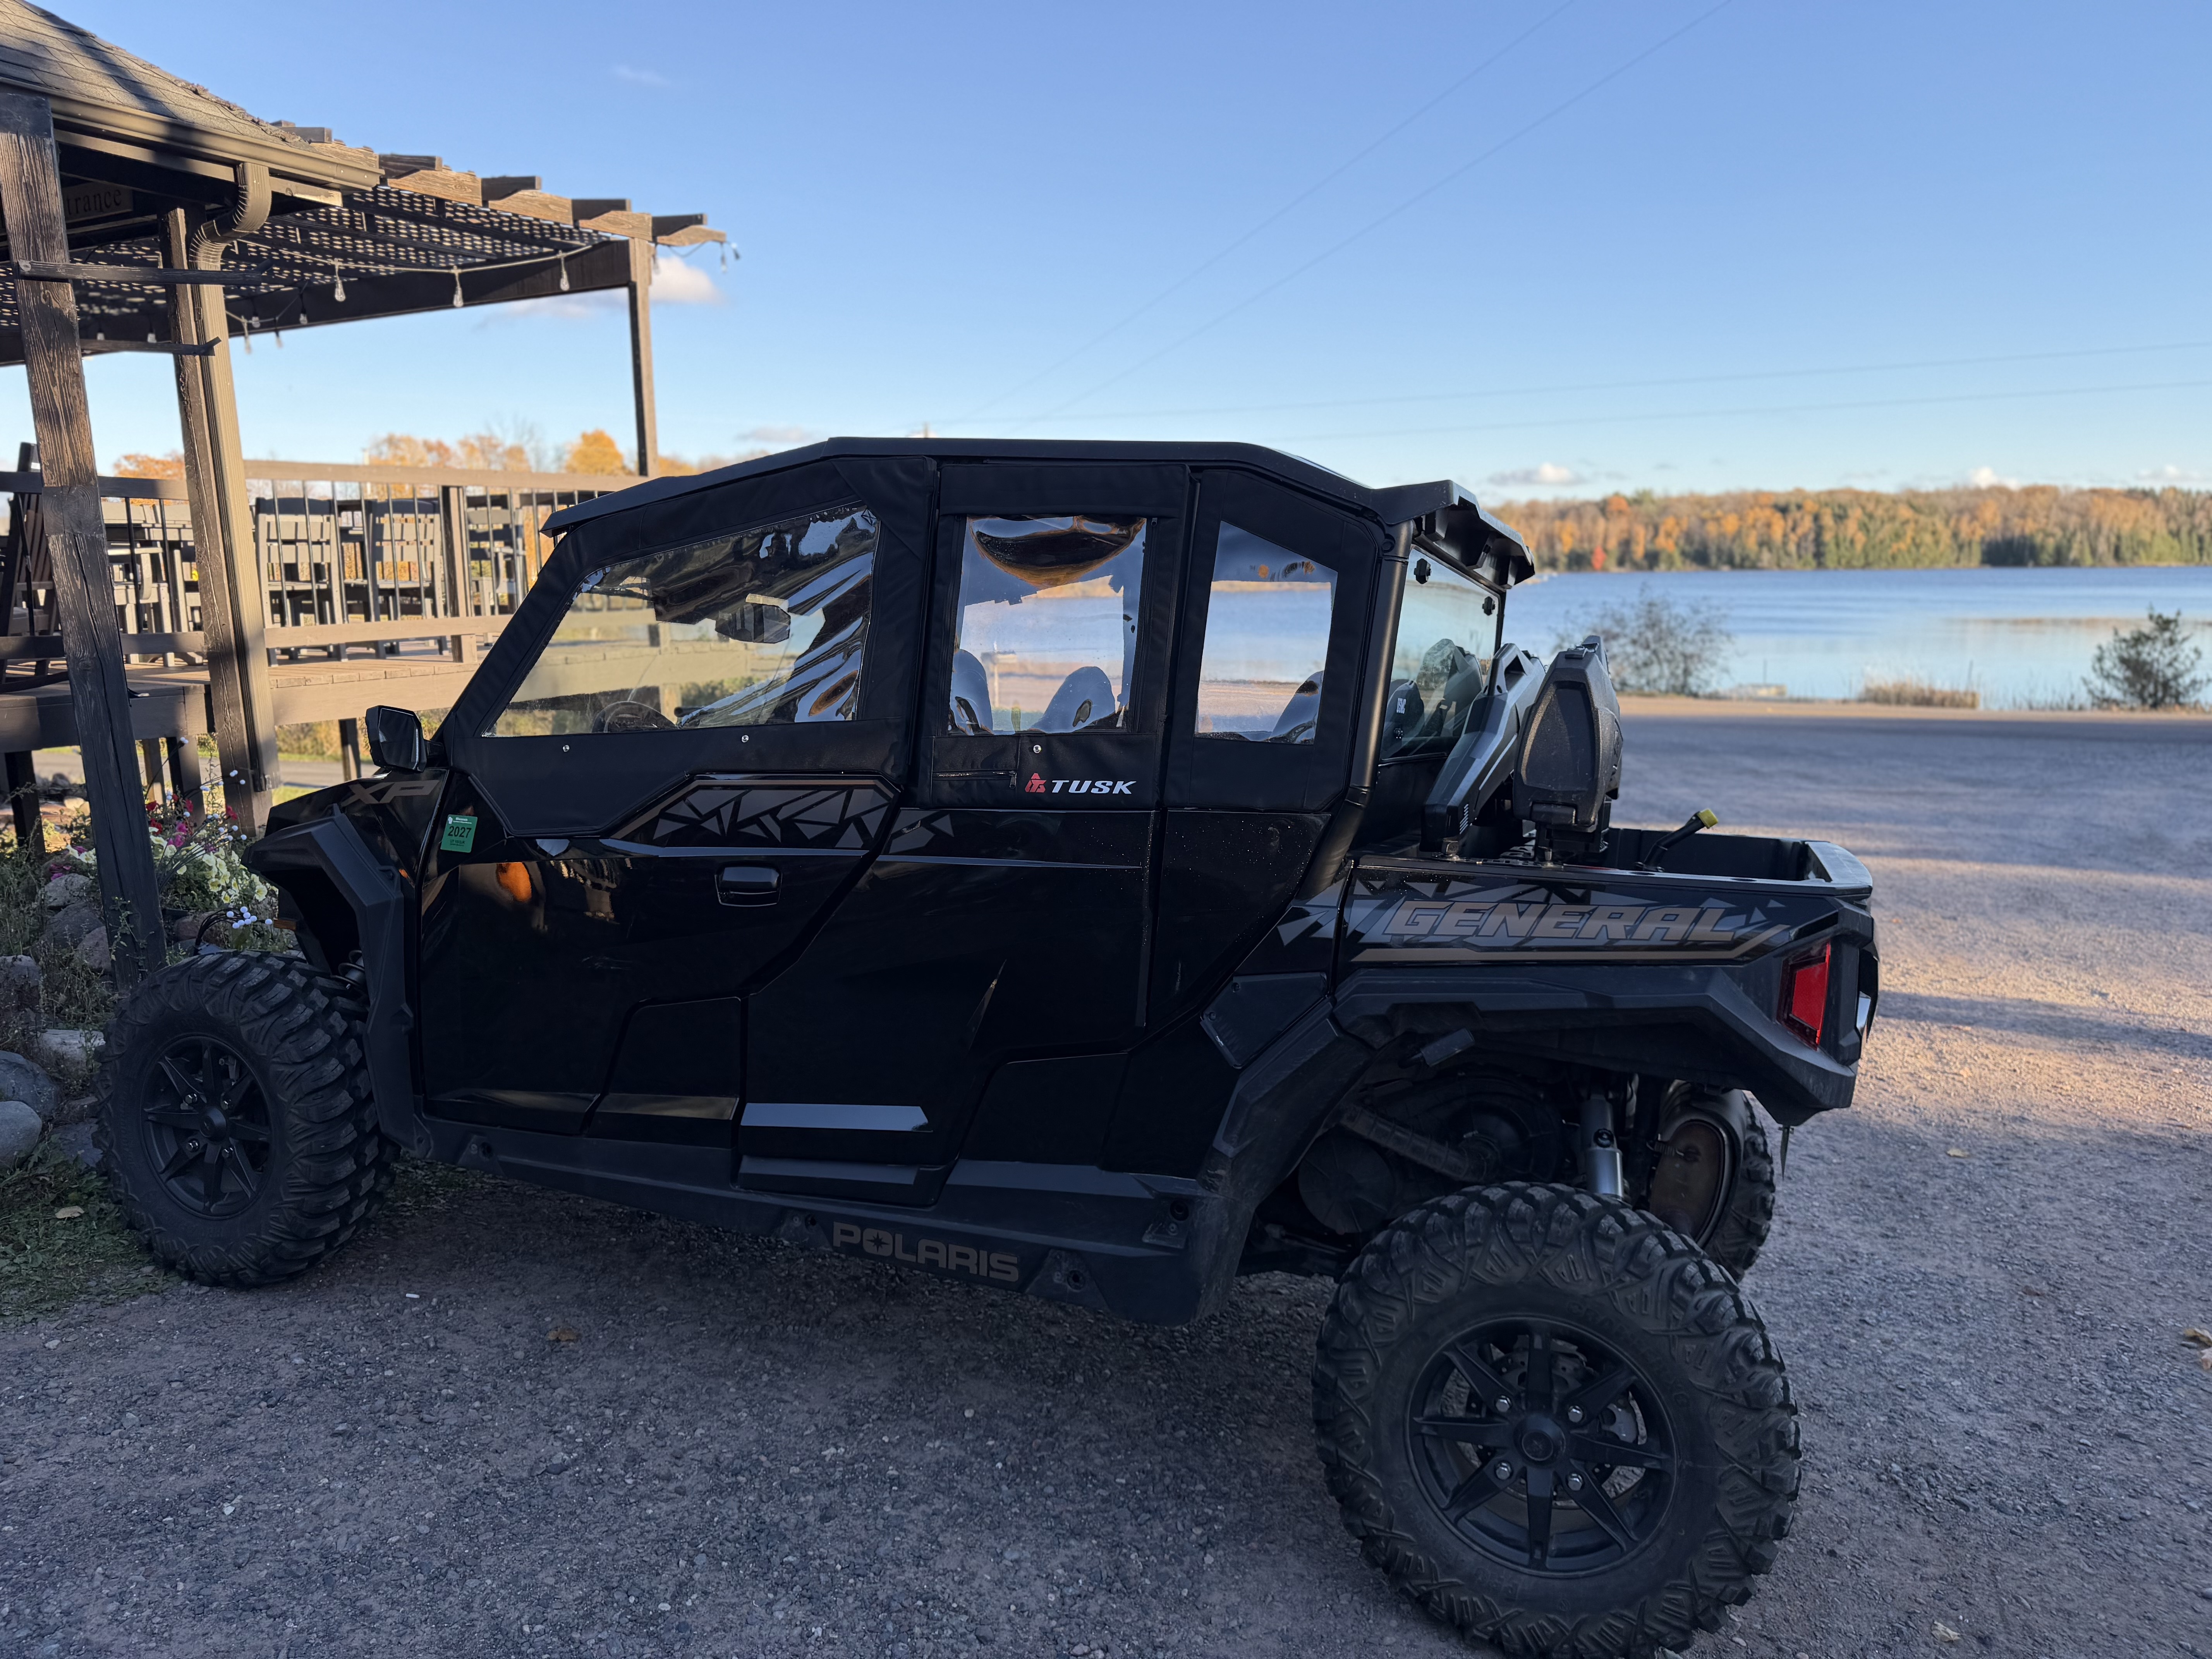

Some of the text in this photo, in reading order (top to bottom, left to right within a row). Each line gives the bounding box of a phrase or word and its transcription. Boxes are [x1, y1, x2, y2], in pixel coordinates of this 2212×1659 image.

[67, 189, 122, 215] trance
[340, 780, 439, 807] XP
[1052, 780, 1137, 794] TUSK
[448, 826, 472, 838] 2027
[1383, 900, 1735, 941] GENERAL
[833, 1221, 1019, 1282] POLARIS
